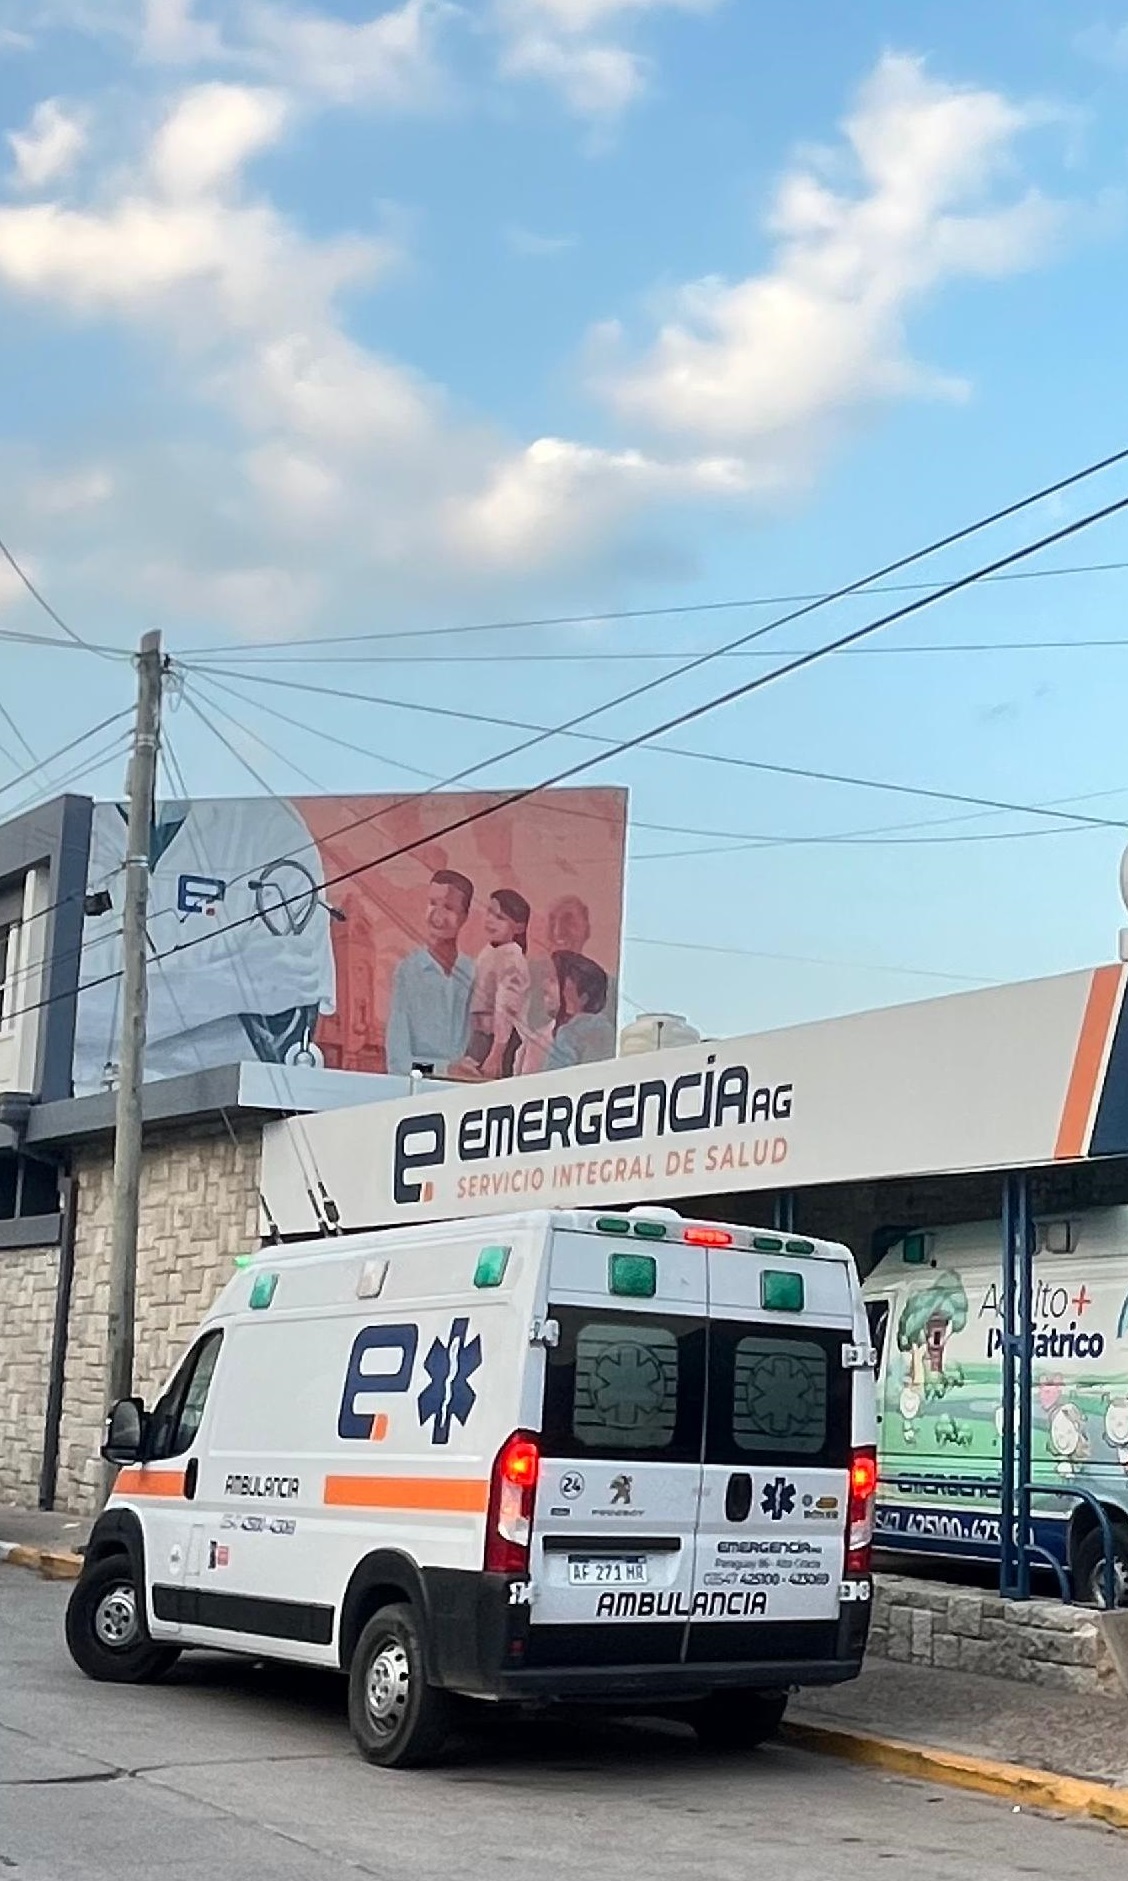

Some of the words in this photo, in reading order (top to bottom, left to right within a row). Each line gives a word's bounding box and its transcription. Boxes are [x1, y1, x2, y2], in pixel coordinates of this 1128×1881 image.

[457, 1167, 544, 1199] SERVICIO
[552, 1155, 655, 1188] INTEGRAL
[665, 1147, 696, 1175] DE
[705, 1136, 788, 1172] SALUD
[563, 1477, 581, 1493] 24
[595, 1565, 621, 1580] 271
[596, 1591, 768, 1617] AMBULANCIA
